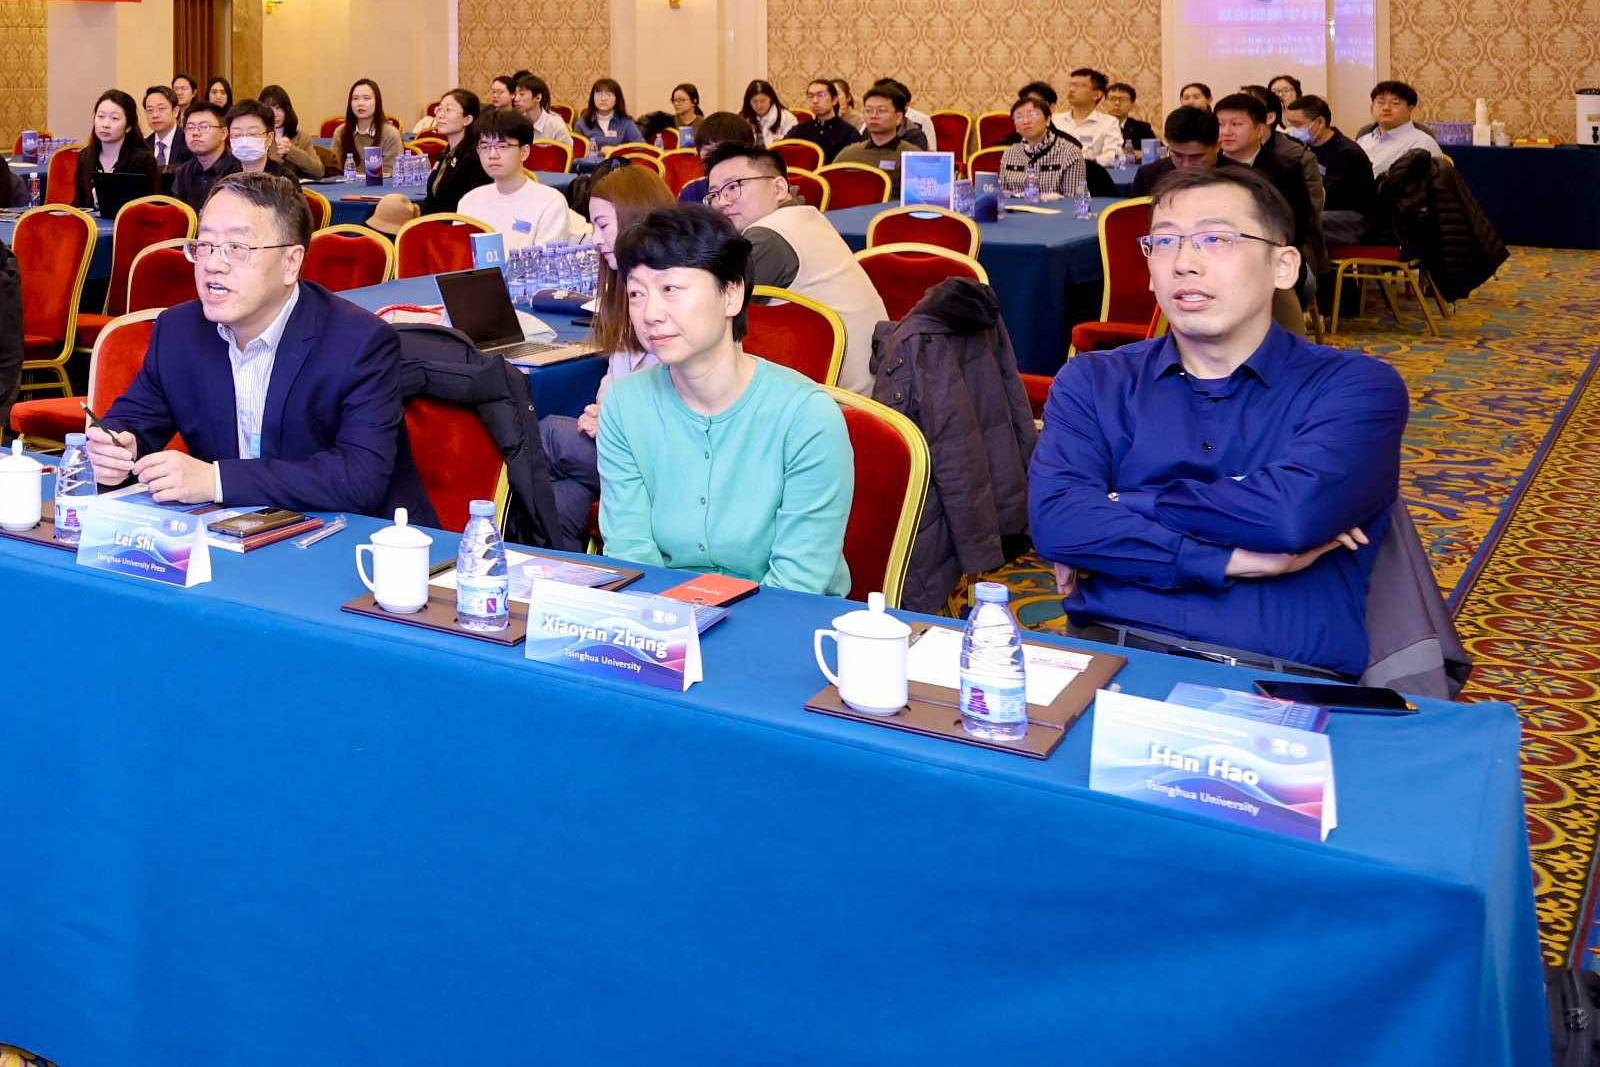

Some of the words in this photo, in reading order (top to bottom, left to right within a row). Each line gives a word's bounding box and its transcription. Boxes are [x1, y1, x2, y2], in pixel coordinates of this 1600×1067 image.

[486, 250, 499, 263] 01
[115, 531, 133, 547] Lei
[135, 534, 156, 552] Shi
[122, 557, 150, 572] University
[151, 563, 166, 573] Press
[542, 615, 607, 643] Xiaoyan
[612, 628, 669, 658] Zhang
[563, 647, 599, 663] Tsinghua
[601, 655, 642, 674] University
[1150, 743, 1199, 774] Han
[1208, 756, 1259, 786] Hao
[1146, 780, 1198, 801] Tsinghua
[1200, 790, 1260, 817] University
